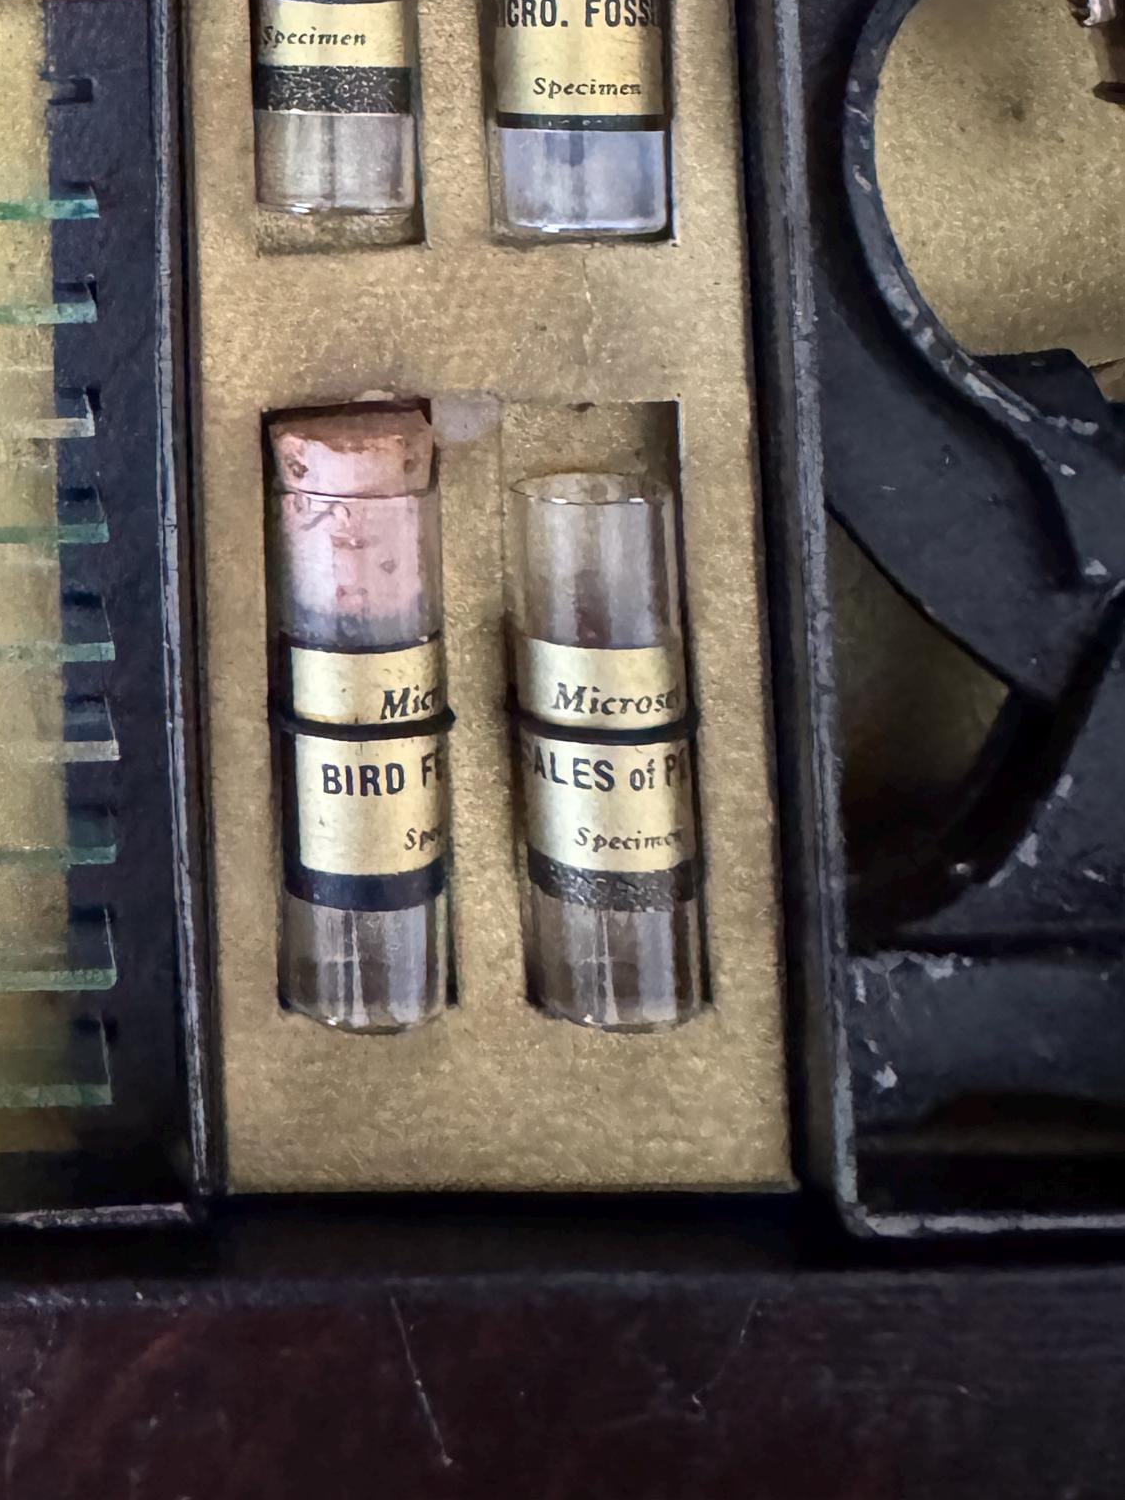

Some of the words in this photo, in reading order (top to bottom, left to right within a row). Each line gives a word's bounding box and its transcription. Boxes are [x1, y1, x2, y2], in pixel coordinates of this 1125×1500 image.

[263, 26, 367, 49] Specimen
[533, 77, 642, 99] Specimen
[321, 763, 406, 796] BIRD
